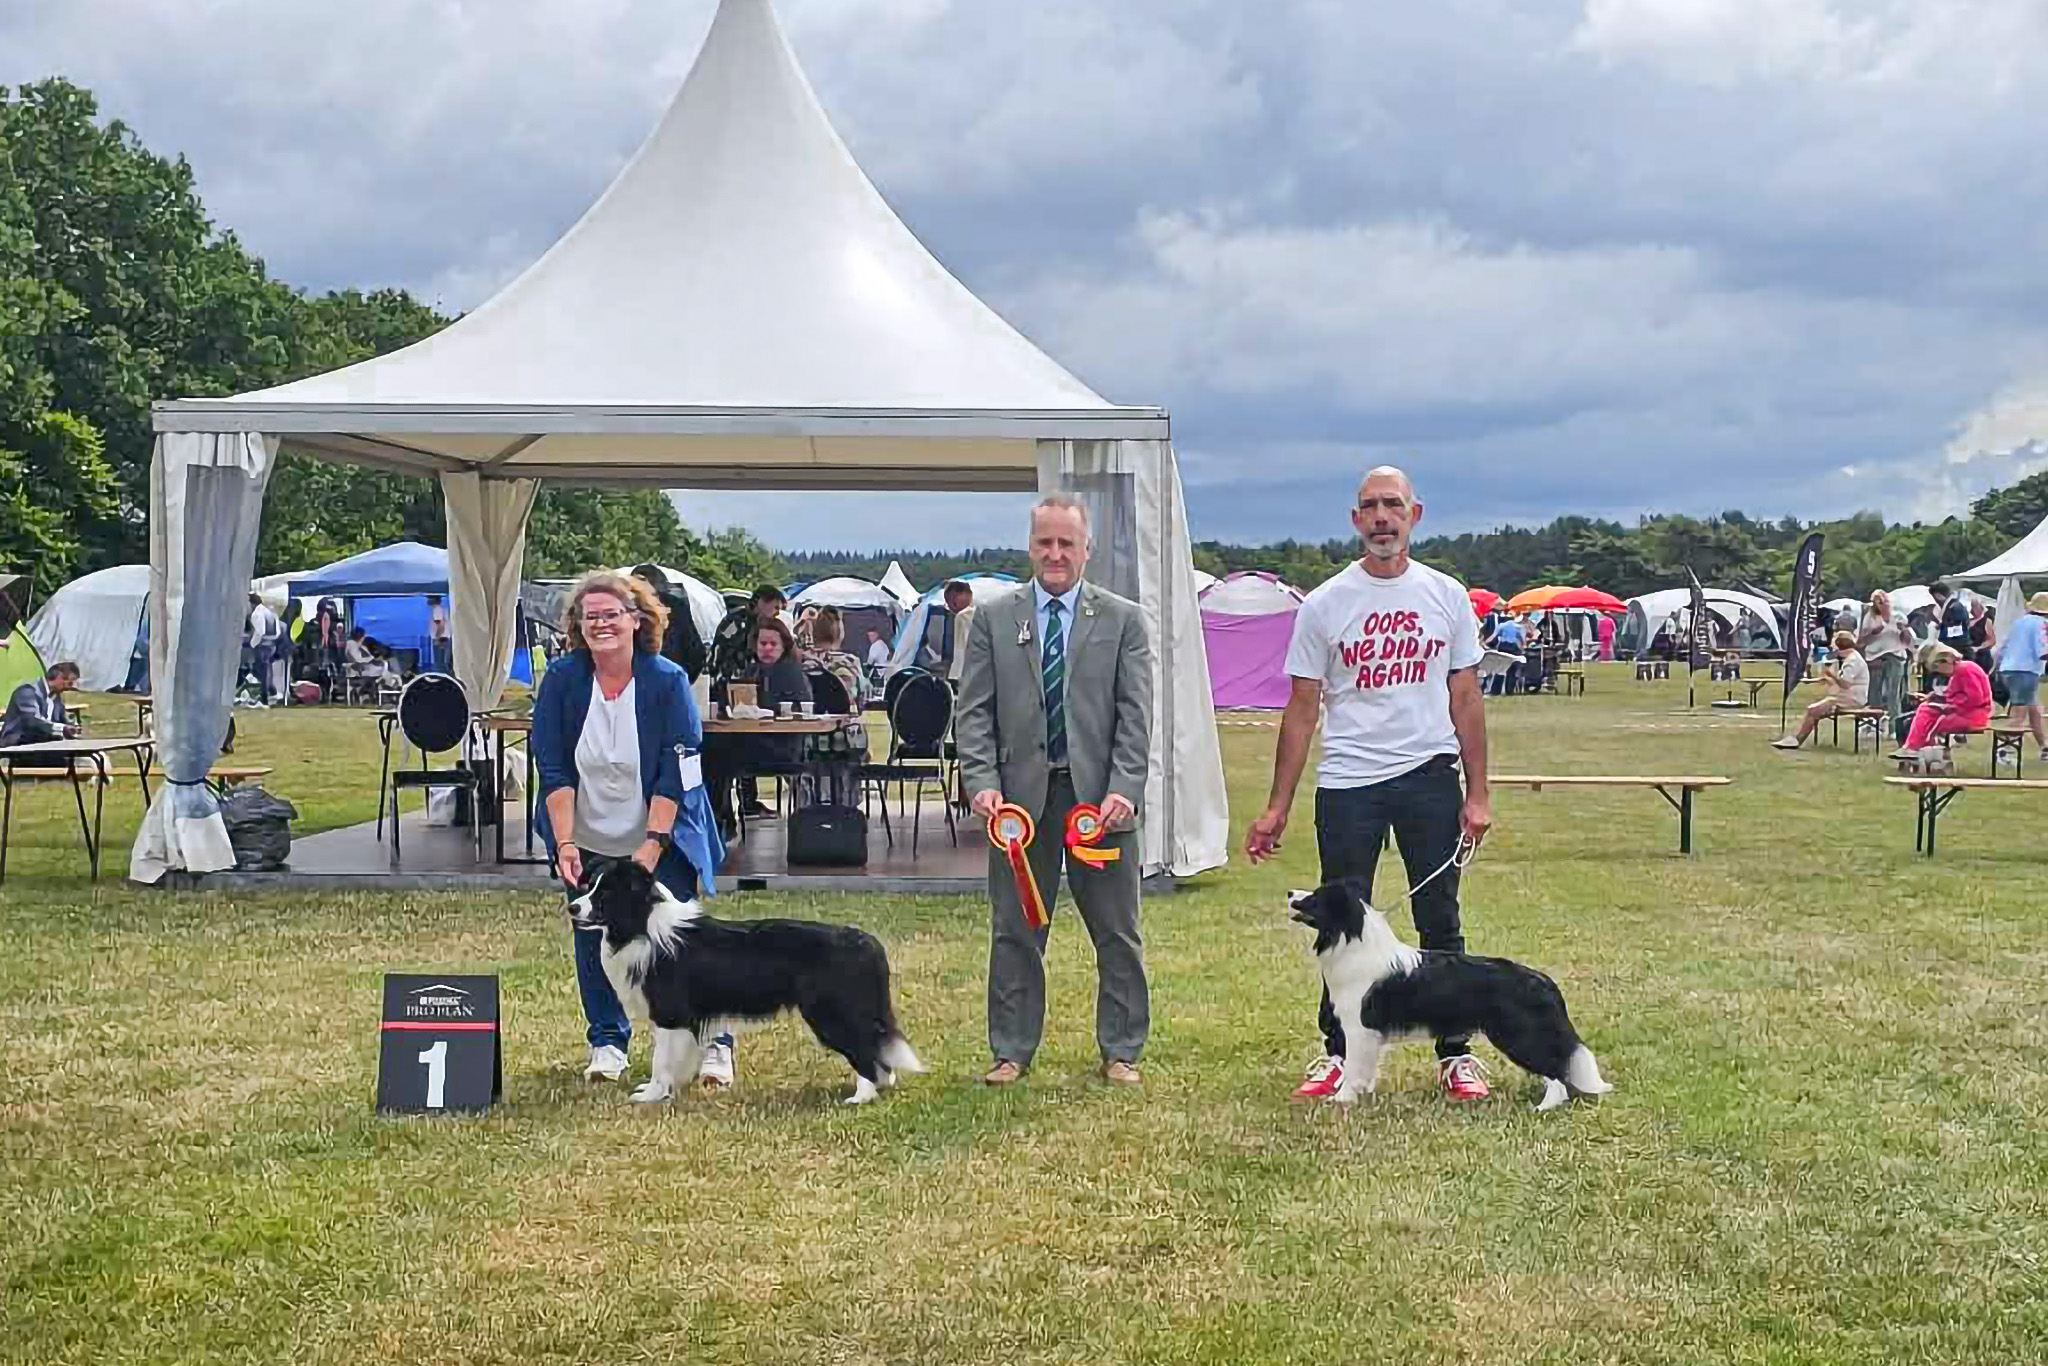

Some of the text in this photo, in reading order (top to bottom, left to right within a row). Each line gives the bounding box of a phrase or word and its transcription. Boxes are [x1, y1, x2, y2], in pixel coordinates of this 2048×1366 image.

[1363, 610, 1424, 636] OOPS,
[1379, 636, 1419, 660] DID
[1424, 639, 1446, 660] IT
[1356, 661, 1427, 690] AGAIN
[418, 1041, 448, 1108] 1
